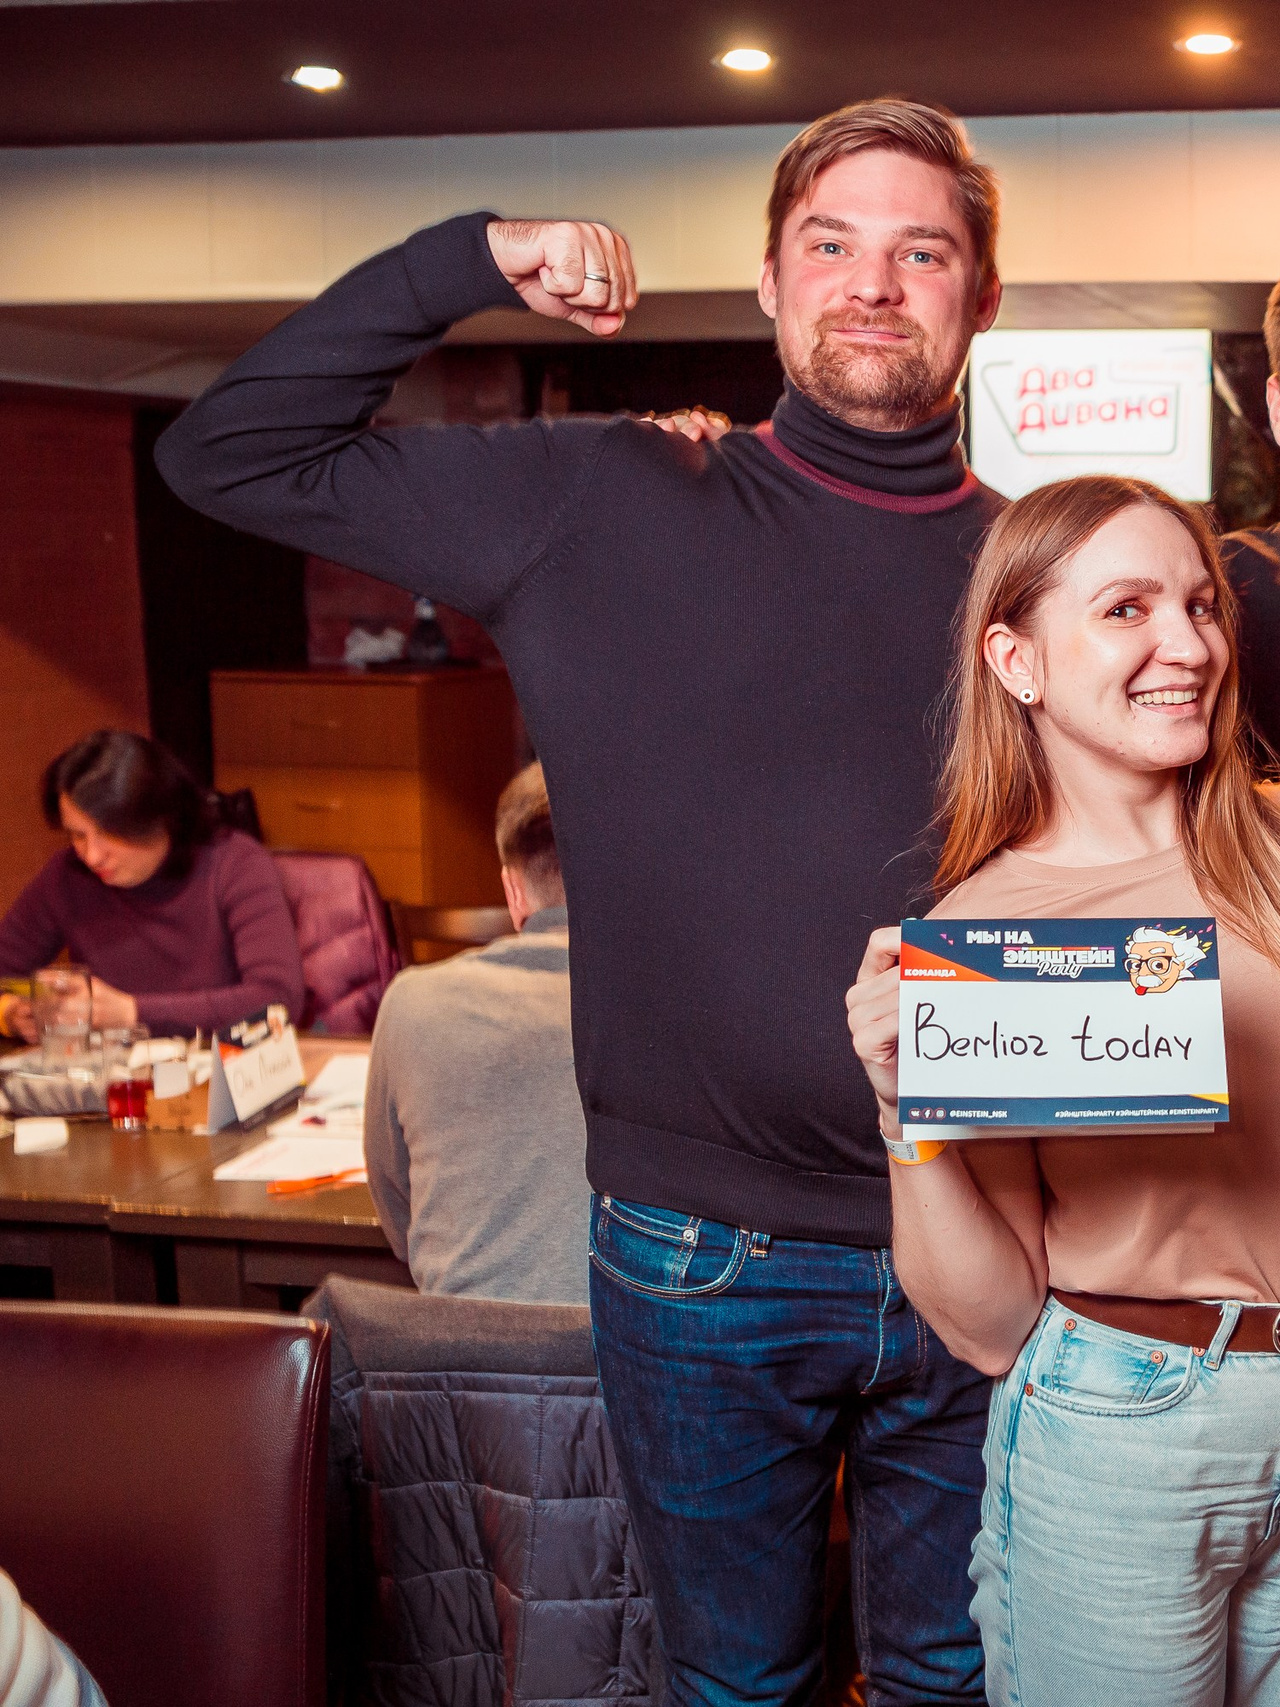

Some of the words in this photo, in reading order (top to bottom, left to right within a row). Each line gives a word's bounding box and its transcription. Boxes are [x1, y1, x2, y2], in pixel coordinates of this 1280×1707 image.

[966, 931, 1001, 944] МЫ
[1004, 931, 1034, 944] НА
[904, 969, 957, 977] КОМАНДА
[1036, 961, 1084, 978] Party
[950, 1110, 1007, 1119] @EINSTEIN_NSK
